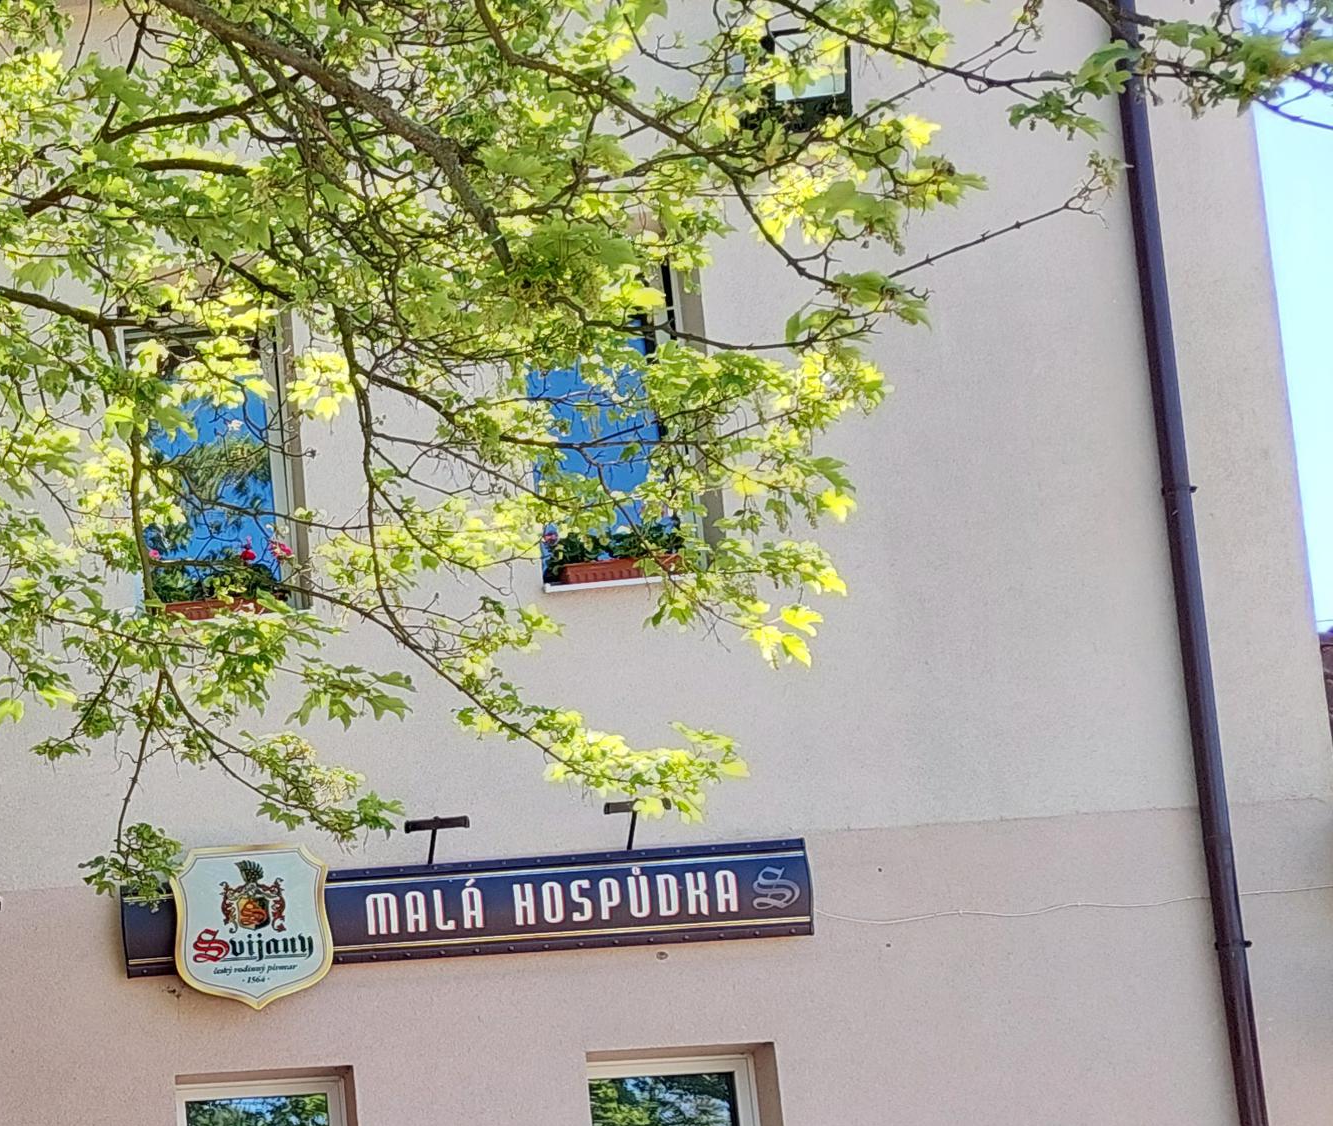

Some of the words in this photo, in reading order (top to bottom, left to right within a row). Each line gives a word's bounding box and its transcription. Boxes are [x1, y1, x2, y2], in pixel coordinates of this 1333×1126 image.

[365, 878, 485, 936] MALÁ
[512, 866, 739, 926] HOSPŮDKA
[193, 928, 313, 963] Svijany
